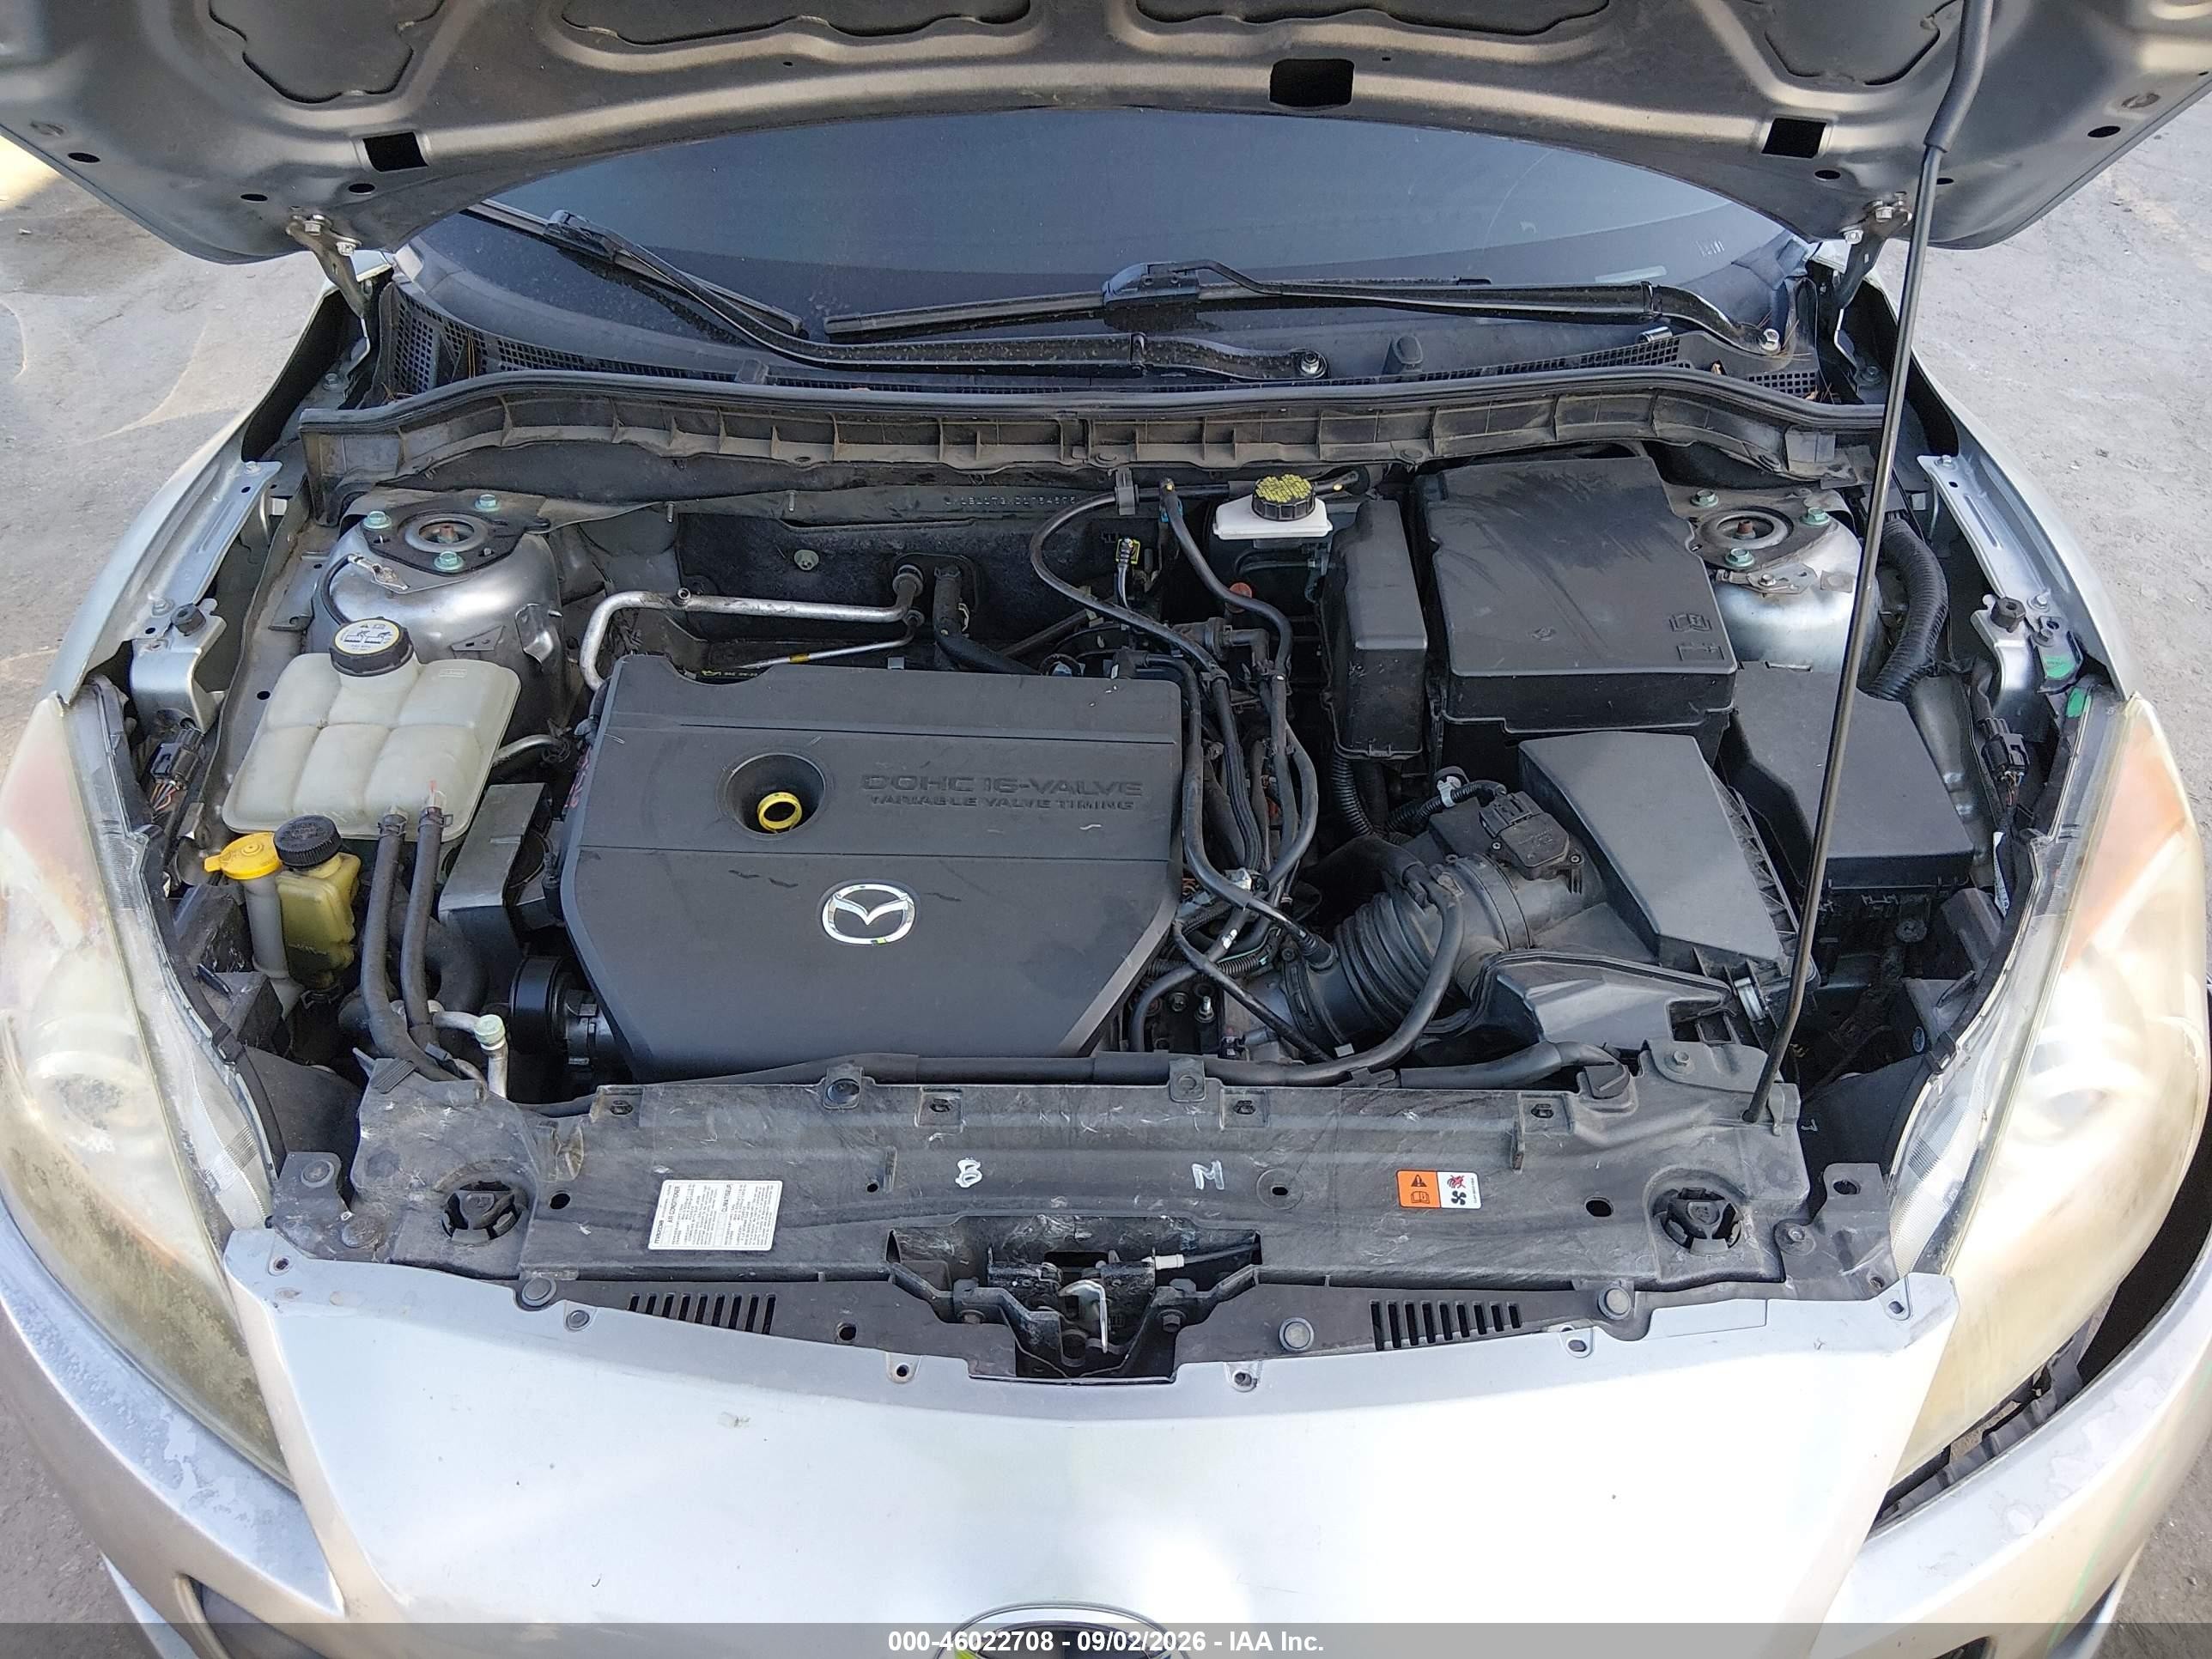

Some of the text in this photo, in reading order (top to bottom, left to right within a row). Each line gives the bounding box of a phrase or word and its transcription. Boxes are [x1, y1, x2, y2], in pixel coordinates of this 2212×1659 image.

[861, 775, 1144, 796] DOHC 16-VALVE
[872, 795, 1134, 811] VARIABLE VALVE TIMING
